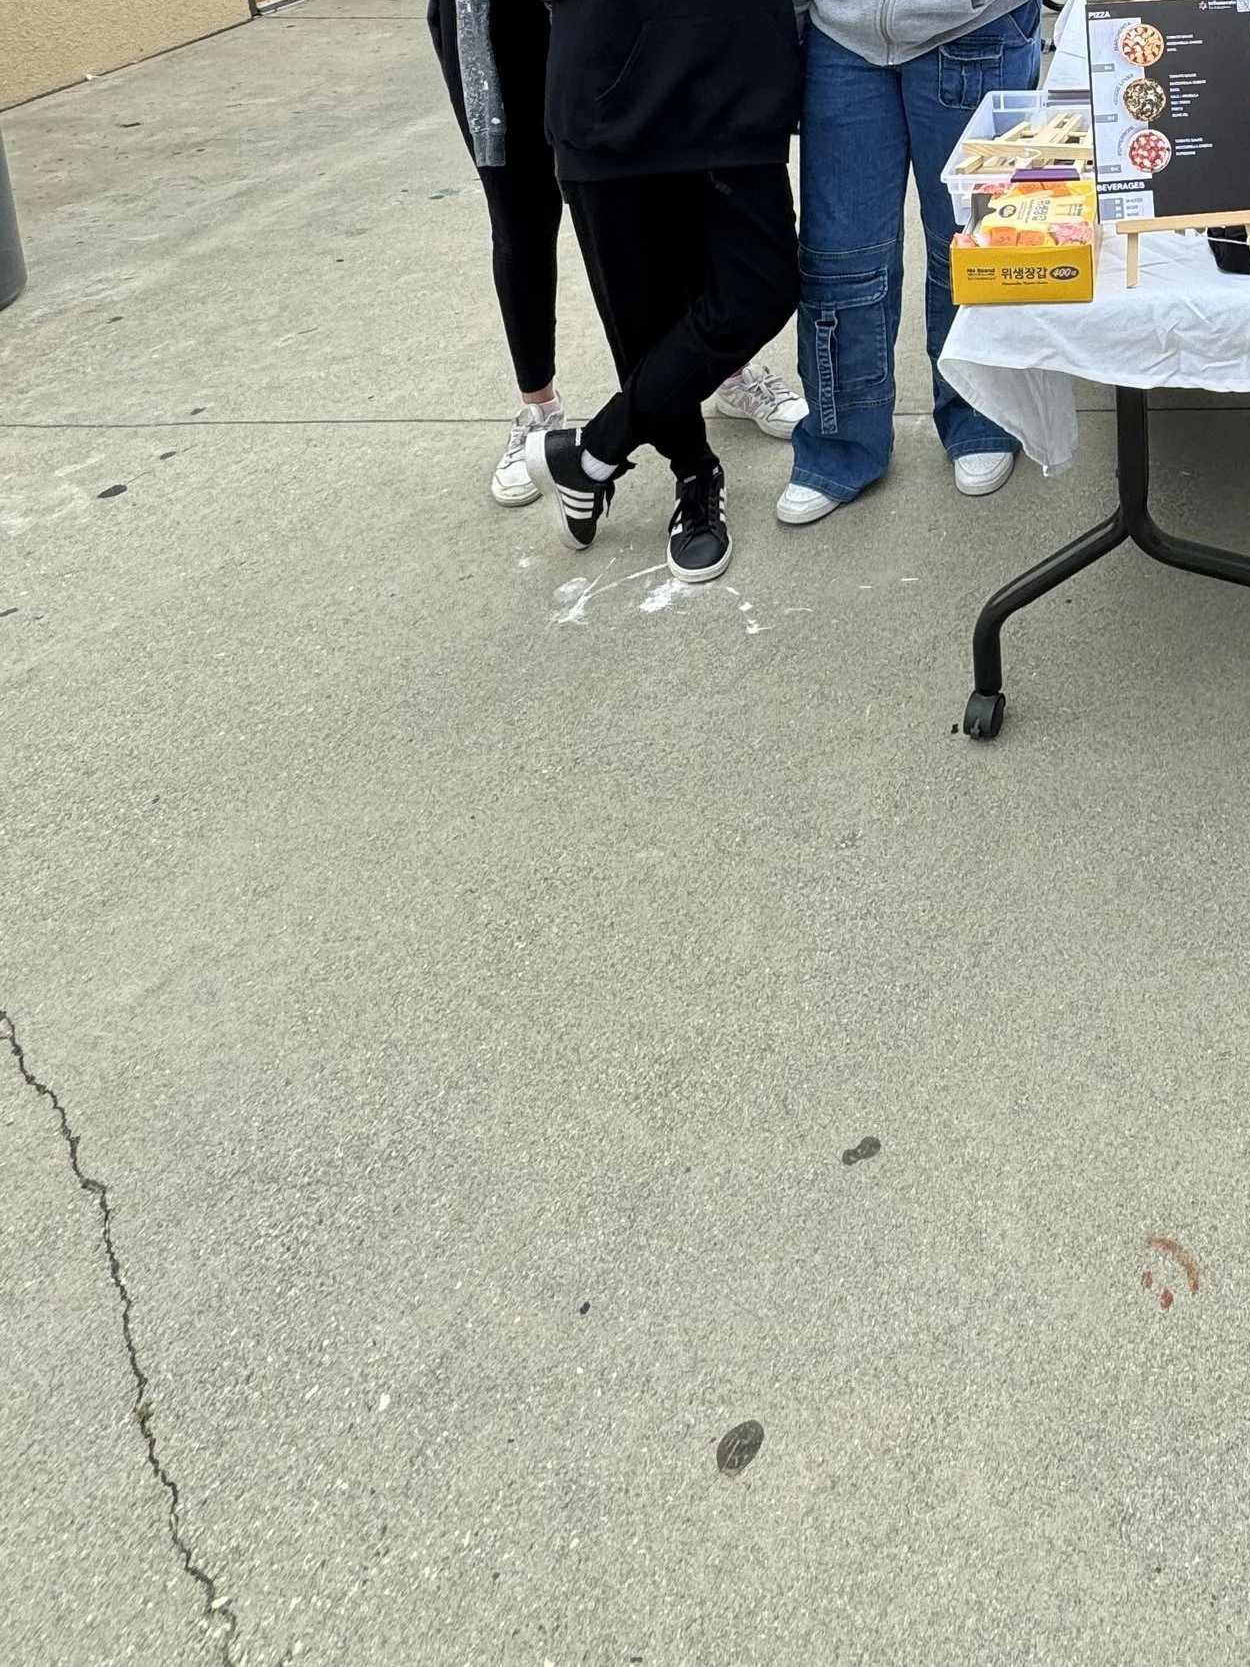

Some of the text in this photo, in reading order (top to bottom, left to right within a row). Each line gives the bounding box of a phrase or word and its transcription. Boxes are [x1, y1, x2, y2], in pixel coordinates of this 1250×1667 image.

[1088, 10, 1111, 19] PIZZA
[1096, 181, 1146, 192] BEVERAGES
[1001, 266, 1049, 280] 위생장갑
